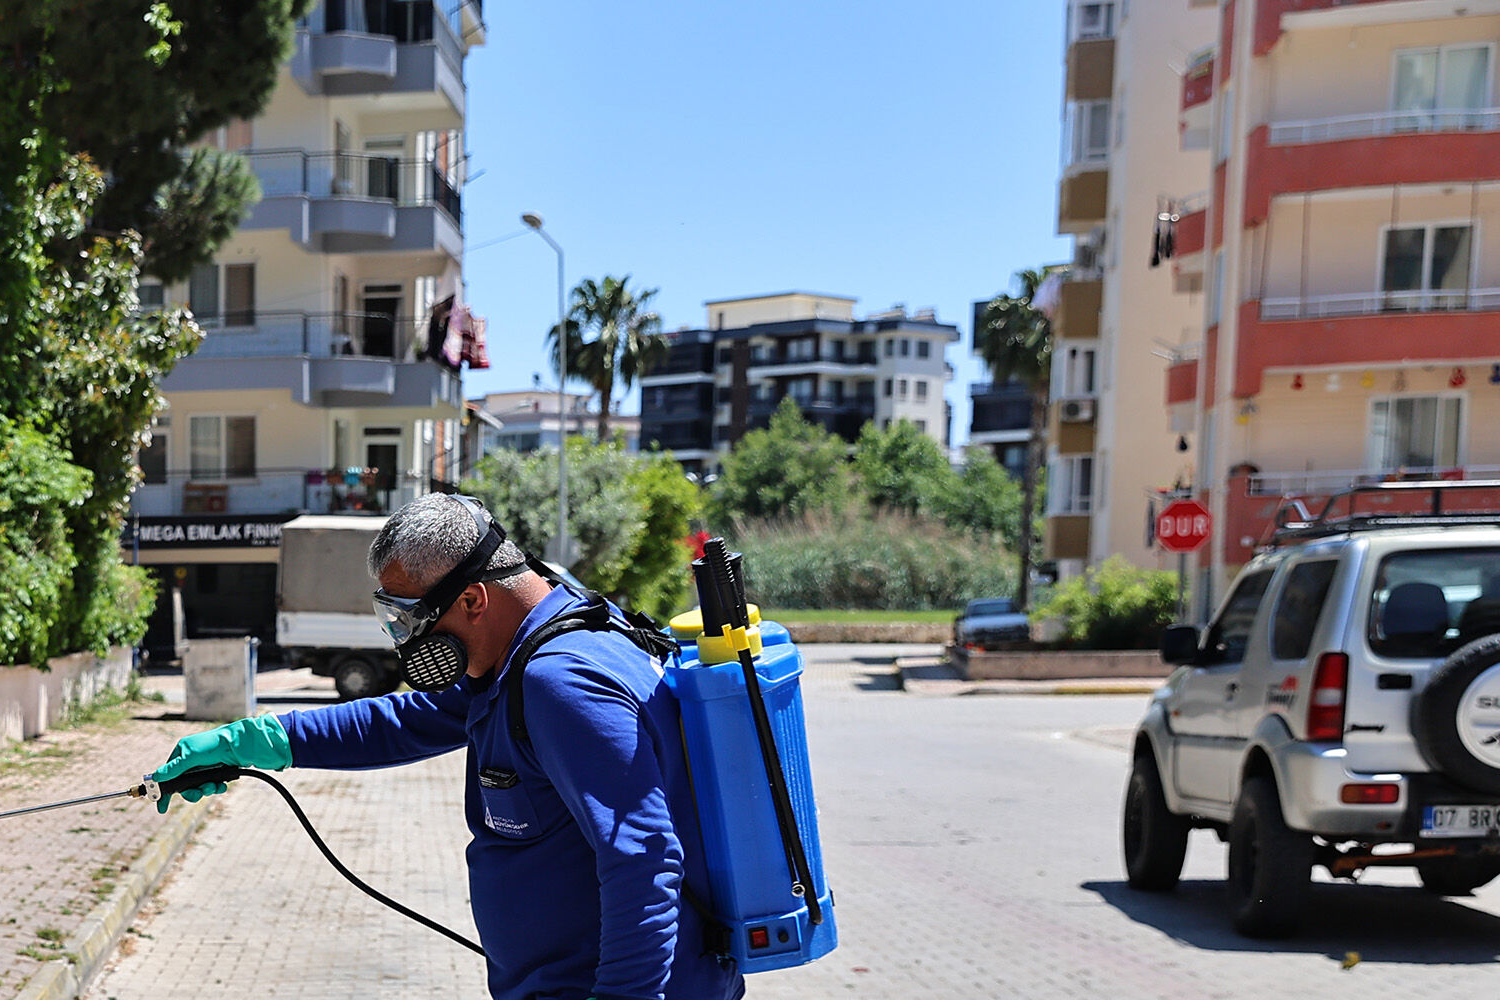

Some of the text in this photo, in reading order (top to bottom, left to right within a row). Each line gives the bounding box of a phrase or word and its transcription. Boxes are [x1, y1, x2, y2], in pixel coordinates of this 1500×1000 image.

[140, 525, 185, 541] MEGA
[187, 524, 241, 540] EMLAK
[1160, 514, 1207, 537] DUR
[1433, 809, 1457, 827] 07
